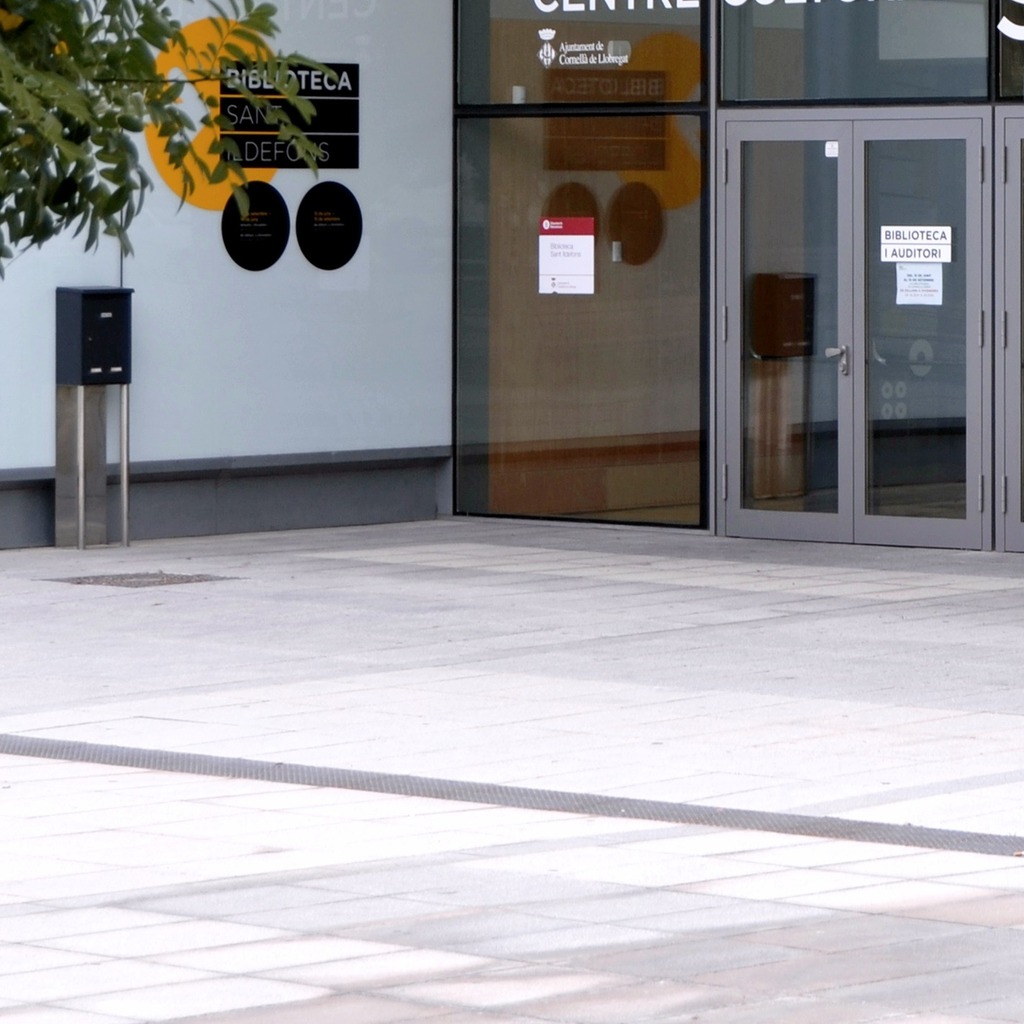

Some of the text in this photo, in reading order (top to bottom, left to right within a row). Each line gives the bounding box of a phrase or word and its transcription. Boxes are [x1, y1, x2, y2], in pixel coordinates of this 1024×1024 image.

[560, 41, 604, 54] Ajuntament de
[589, 55, 598, 64] de
[598, 53, 629, 67] Llobregat
[884, 230, 948, 241] BIBLIOTECA
[884, 248, 942, 259] I AUDITORI
